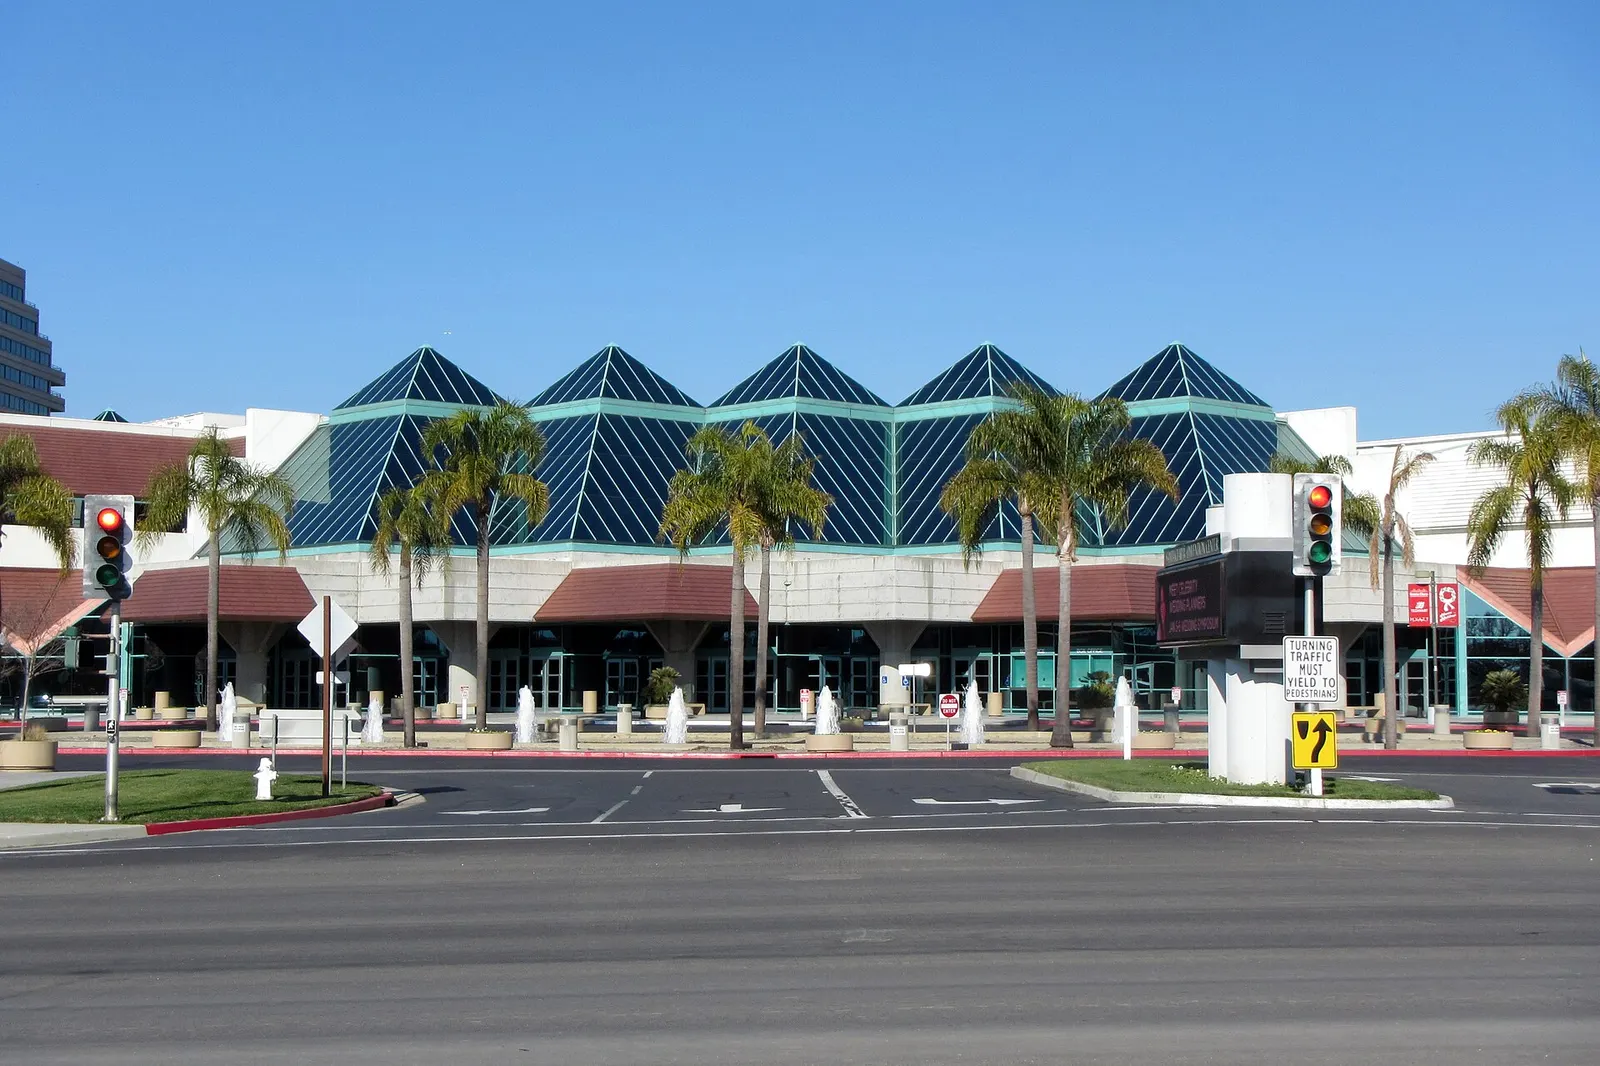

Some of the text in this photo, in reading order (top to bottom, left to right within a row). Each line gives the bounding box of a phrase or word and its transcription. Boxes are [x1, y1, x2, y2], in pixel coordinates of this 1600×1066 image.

[1290, 640, 1333, 651] TURNING
[1290, 651, 1332, 662] TRAFFIC
[1299, 663, 1323, 676] MUST
[1287, 677, 1336, 688] YIELD TO
[1286, 688, 1336, 698] PEDESTRIANS
